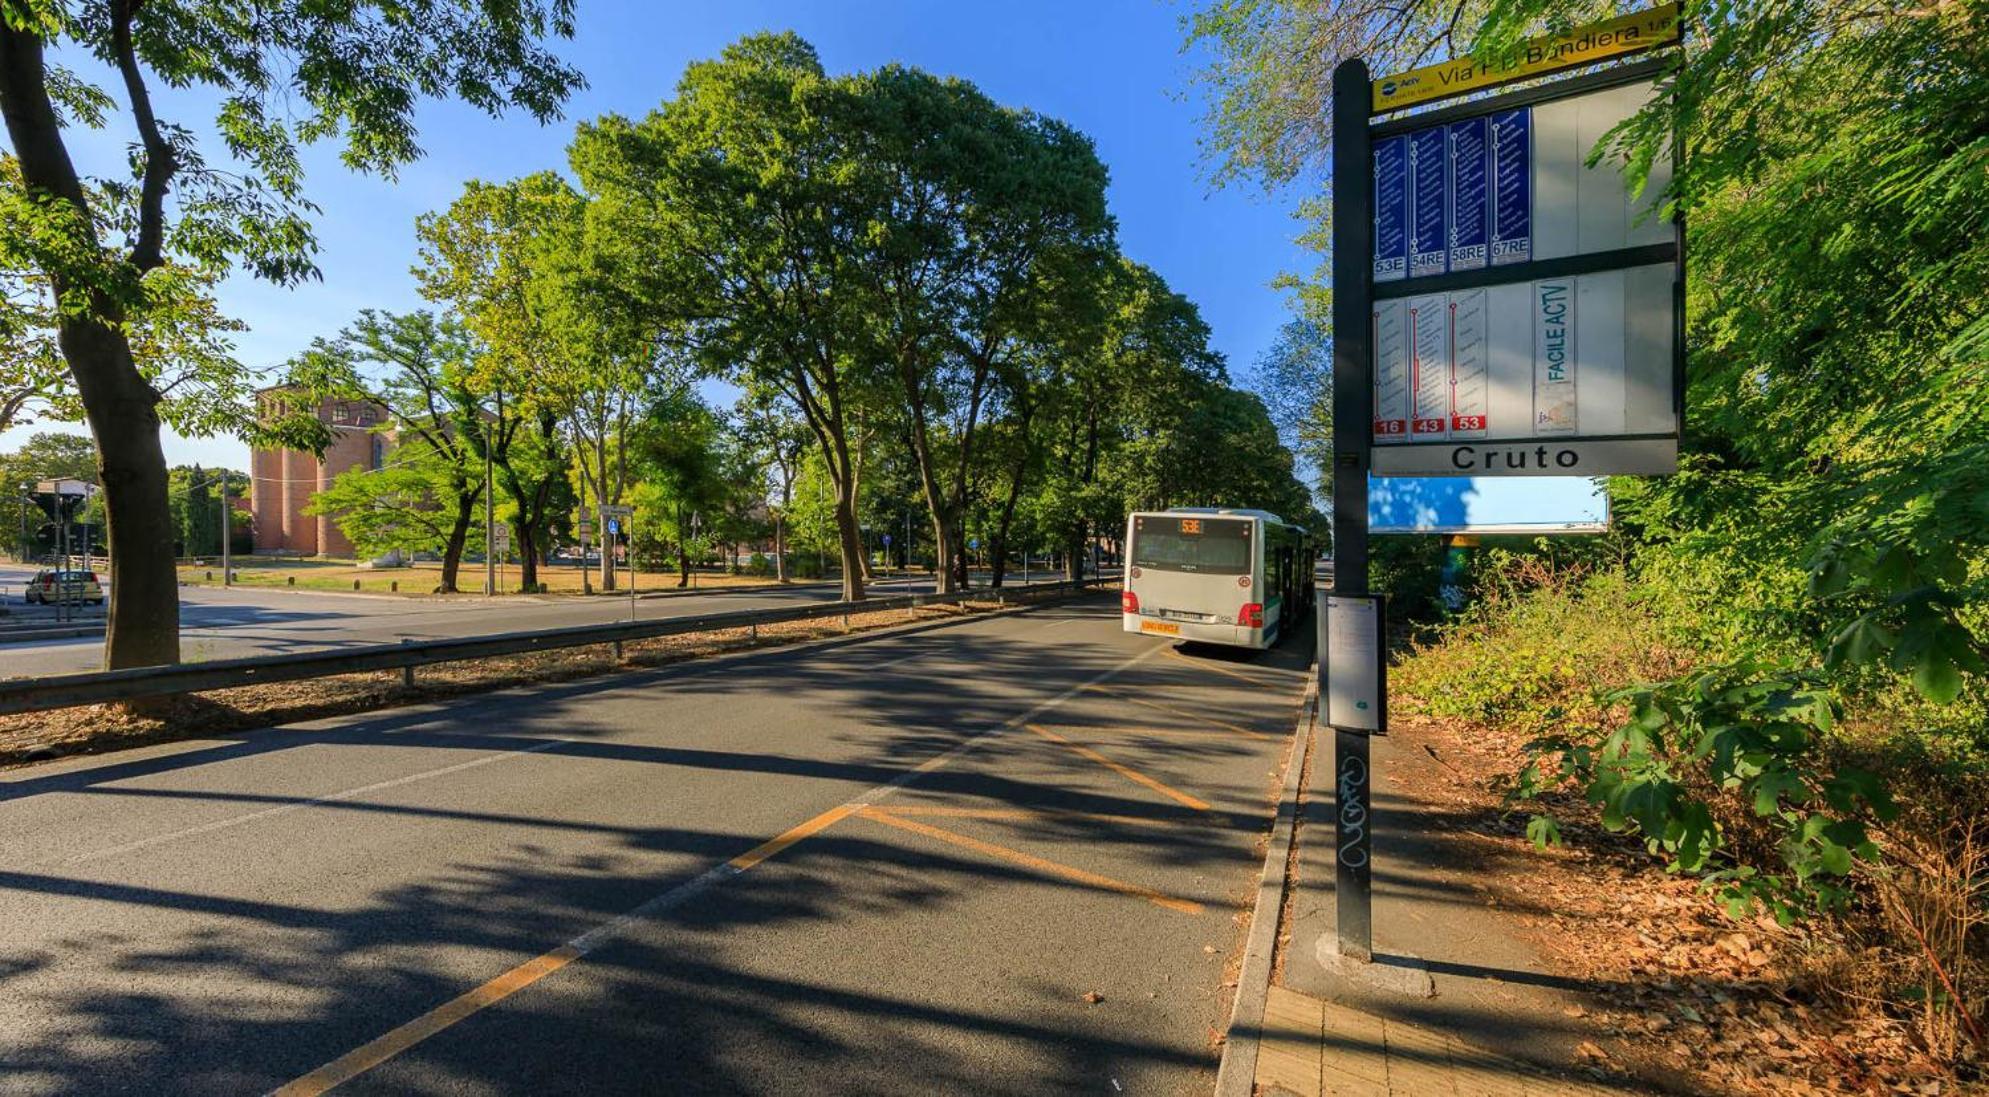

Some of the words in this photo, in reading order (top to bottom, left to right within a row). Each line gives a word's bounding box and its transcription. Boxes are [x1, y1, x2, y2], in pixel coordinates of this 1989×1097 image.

[1438, 66, 1473, 86] Via
[1451, 245, 1485, 261] 58RE
[1493, 240, 1528, 256] 67RE
[1375, 258, 1404, 273] 53E
[1412, 251, 1444, 267] 54RE
[1540, 285, 1568, 325] ACTV
[1546, 328, 1566, 382] FACILE
[1381, 421, 1399, 433] 16
[1418, 419, 1439, 432] 43
[1459, 417, 1480, 430] 53
[1452, 445, 1579, 470] Cruto
[1182, 519, 1201, 534] 53E
